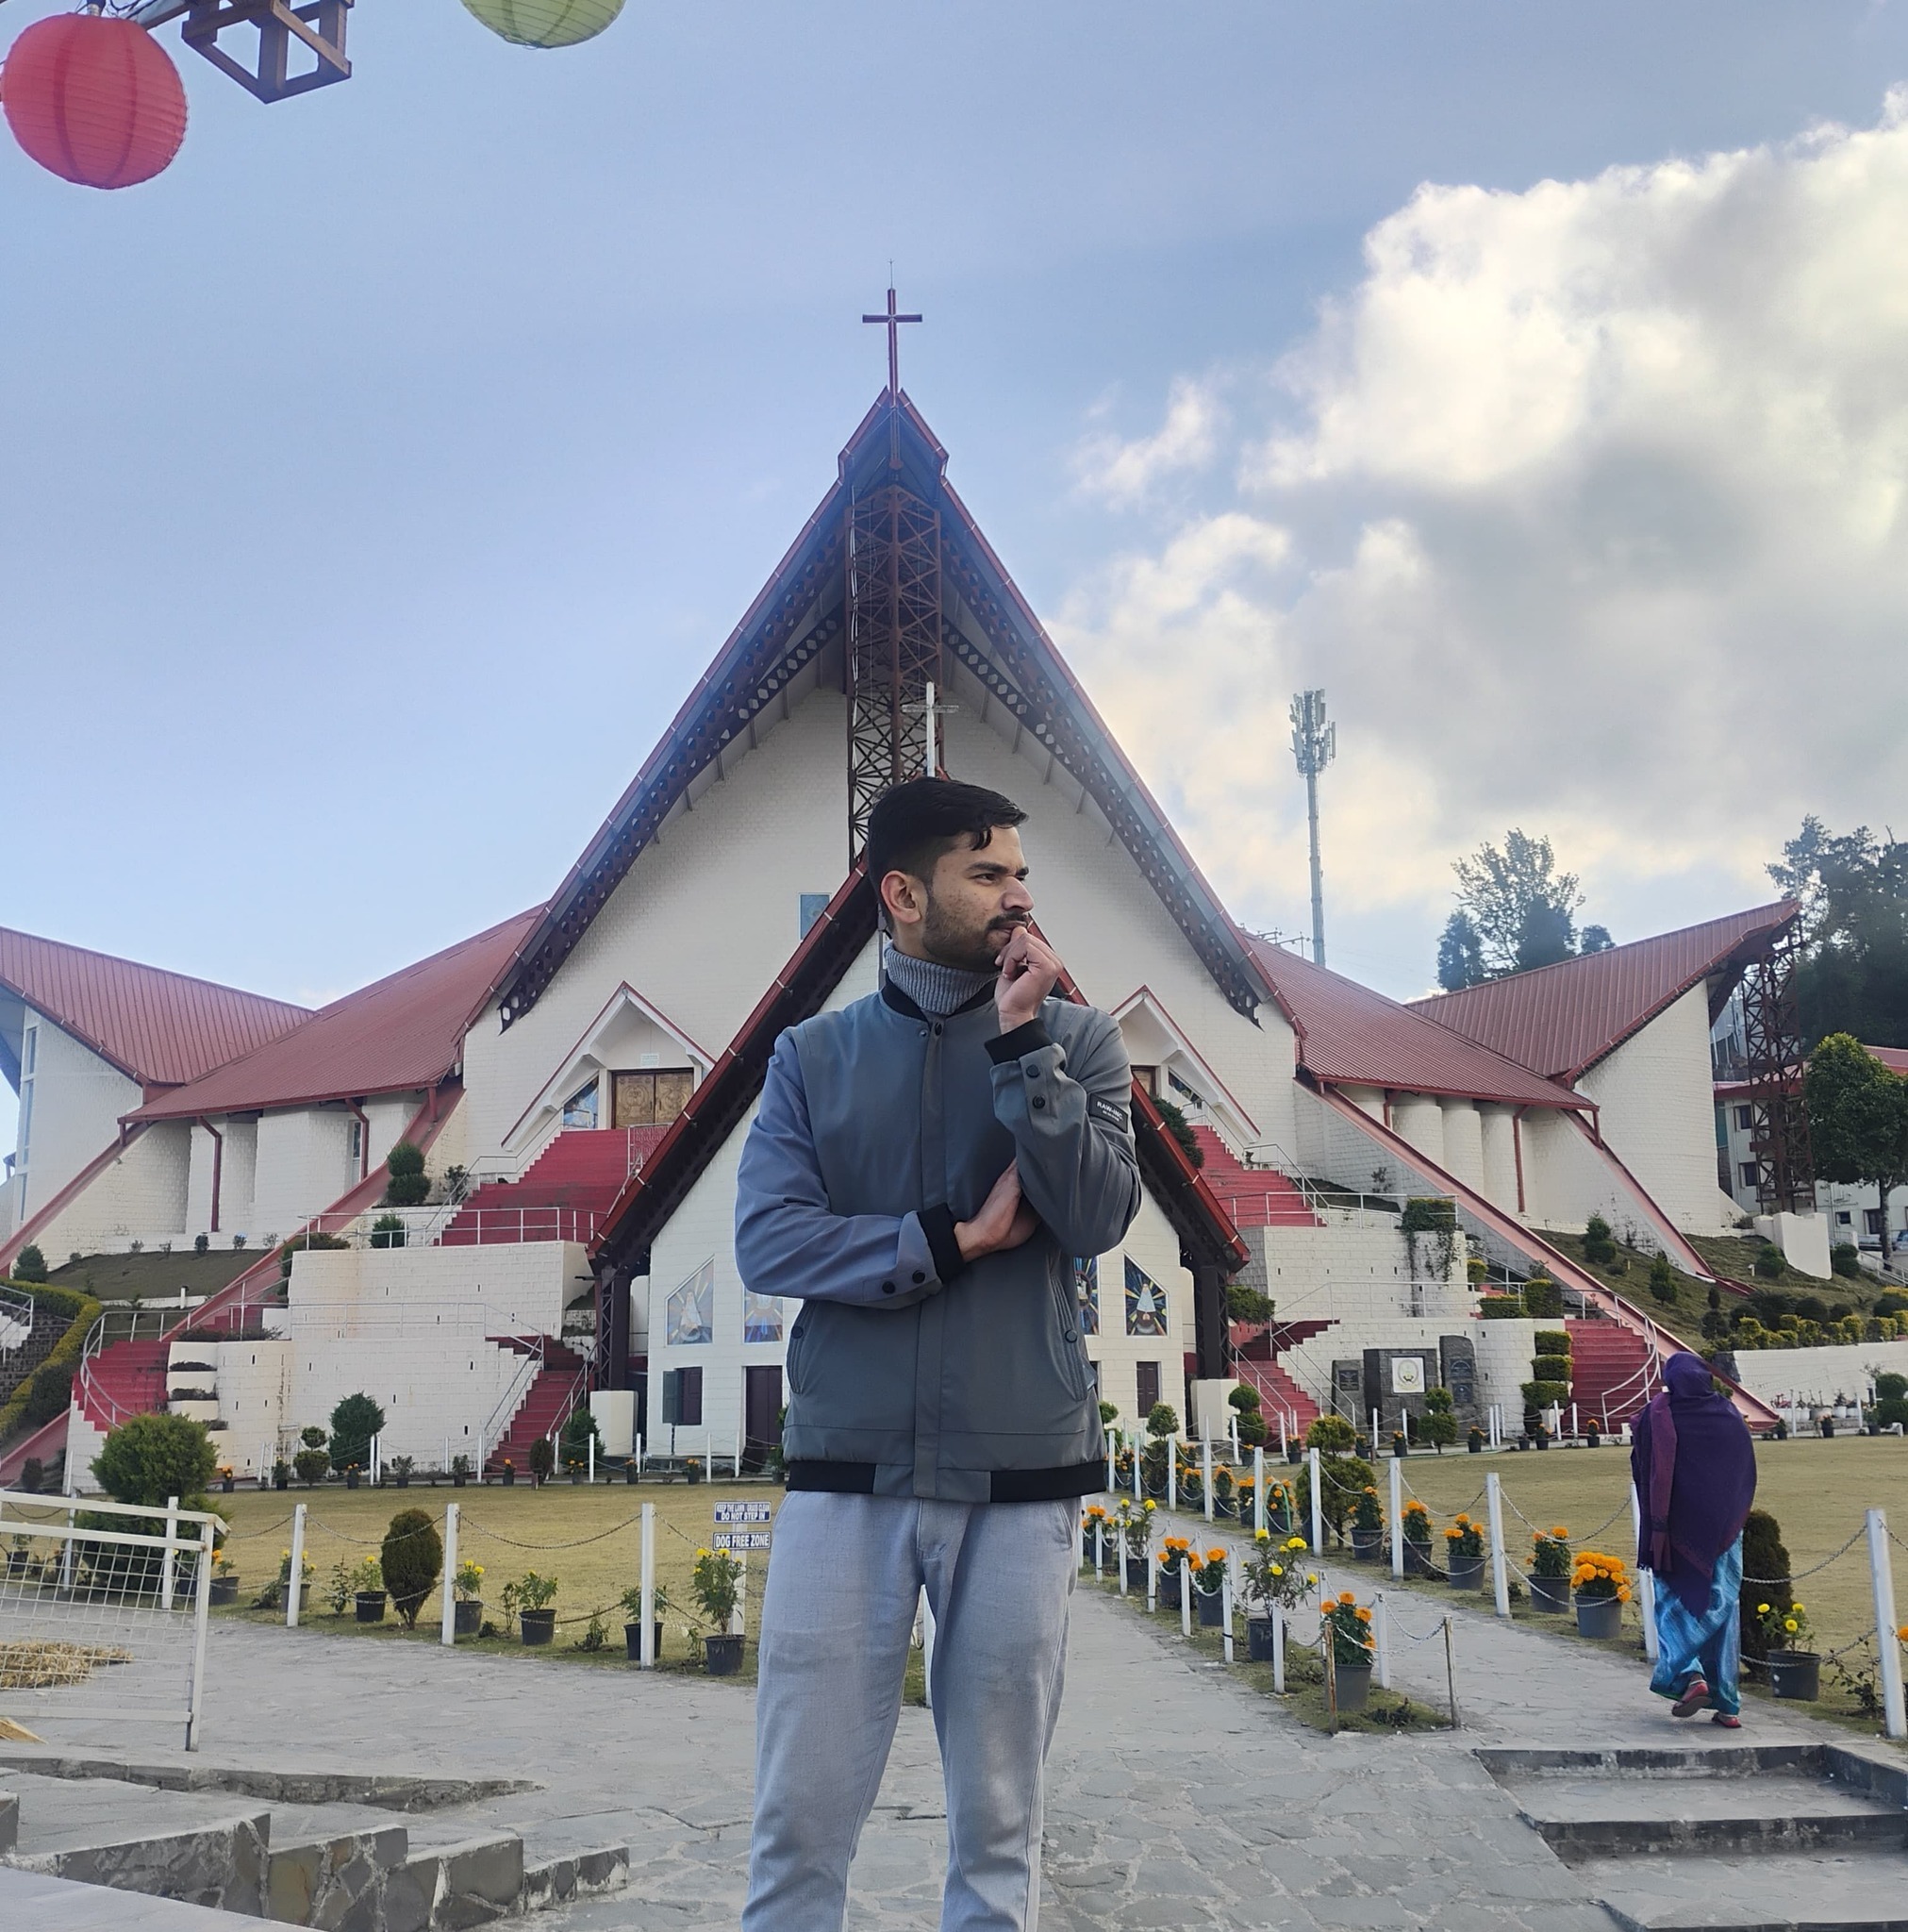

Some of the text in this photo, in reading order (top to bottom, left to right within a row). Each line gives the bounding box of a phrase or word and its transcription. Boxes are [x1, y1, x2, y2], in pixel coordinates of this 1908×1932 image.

[722, 1512, 765, 1521] DO NOT STEP IN
[716, 1534, 769, 1548] DOG FREE ZONE
